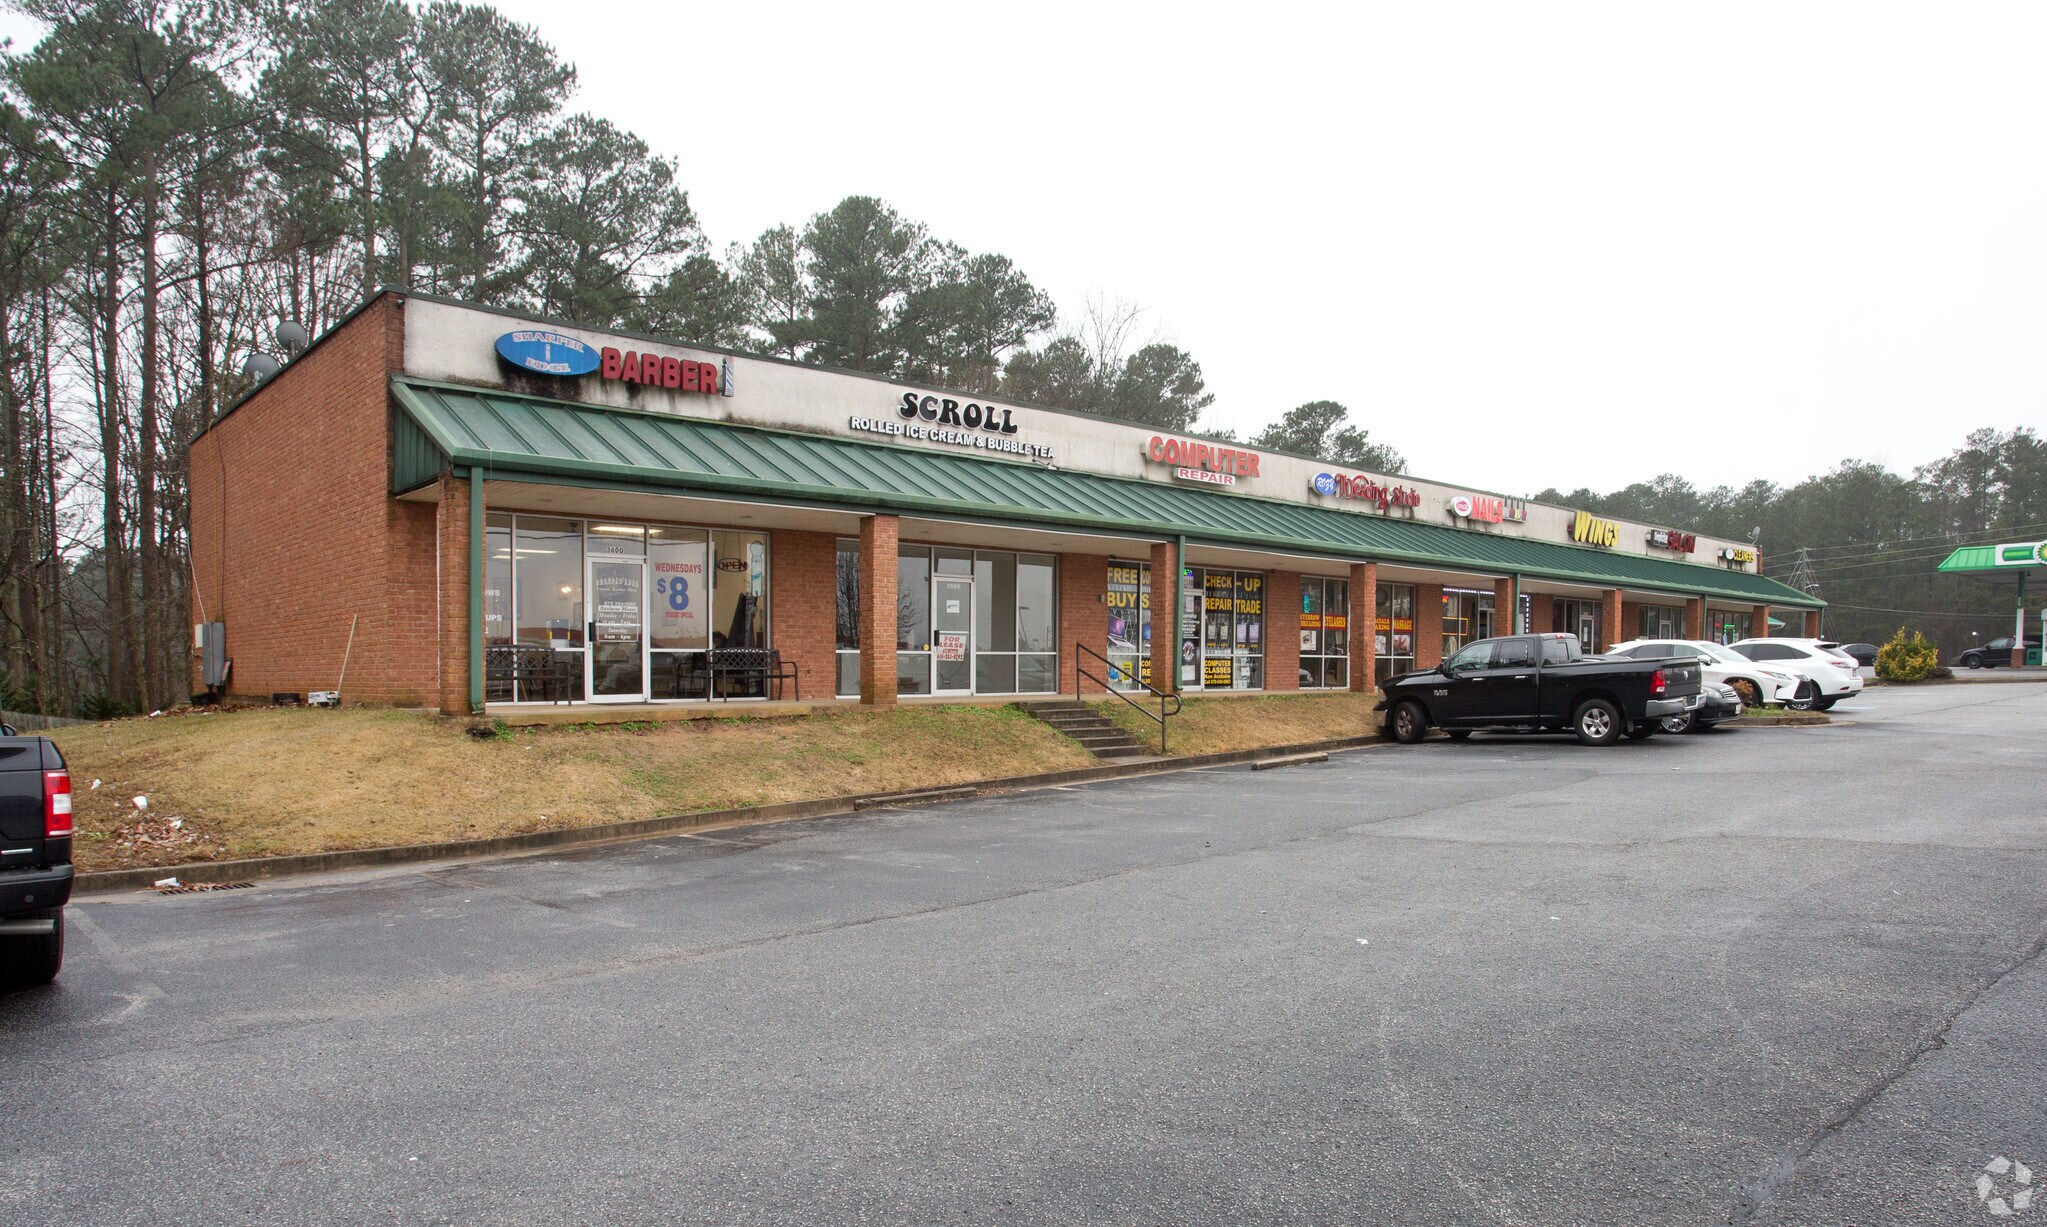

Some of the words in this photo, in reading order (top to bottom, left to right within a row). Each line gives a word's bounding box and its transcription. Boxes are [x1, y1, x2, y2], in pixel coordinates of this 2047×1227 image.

[525, 357, 571, 373] EDGE
[601, 346, 718, 394] BARBER
[897, 391, 1018, 434] SCROLL
[850, 416, 903, 435] ROLLED
[905, 424, 927, 439] ICE
[928, 429, 974, 447] CREAM
[976, 436, 985, 448] &
[986, 437, 1032, 455] BUBBLE
[1032, 444, 1055, 458] TEA
[1147, 435, 1260, 478] COMPUTER
[1179, 468, 1233, 485] REPAIR
[1391, 485, 1420, 507] Studio
[1471, 496, 1503, 524] NAILS
[1573, 510, 1621, 547] WINGS
[606, 546, 624, 554] 3600
[1667, 530, 1696, 553] SALON
[655, 562, 702, 574] WEDNESDAYS
[717, 559, 748, 571] OPEN
[1107, 567, 1138, 584] FREE
[1205, 575, 1233, 588] CHECK
[1244, 577, 1261, 592] UP
[1107, 591, 1137, 608] BUY
[1205, 597, 1233, 610] REPAIR
[1236, 600, 1261, 614] TRADE
